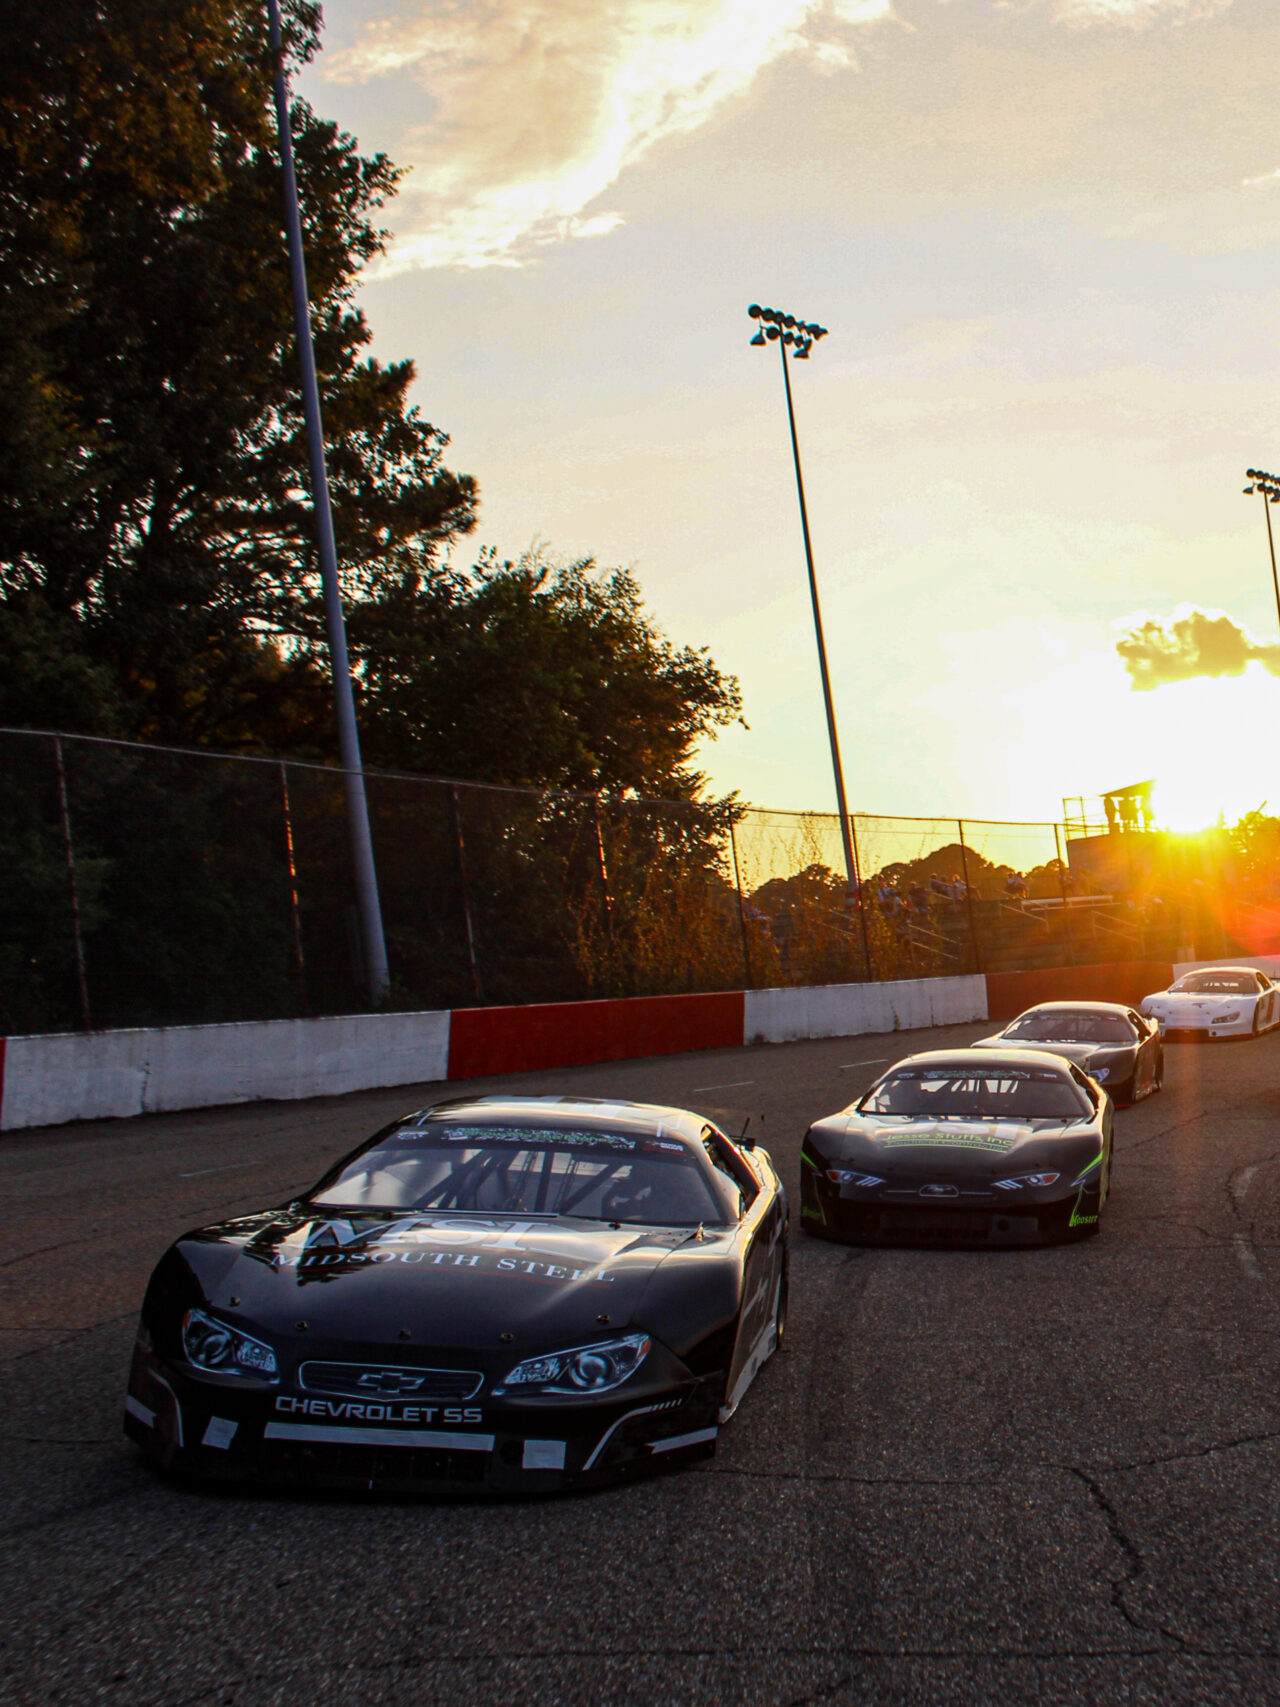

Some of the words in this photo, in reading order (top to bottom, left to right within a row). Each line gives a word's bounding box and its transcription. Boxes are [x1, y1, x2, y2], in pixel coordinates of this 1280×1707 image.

[270, 1251, 480, 1268] MIDSOUTH
[497, 1258, 616, 1283] STEEL
[274, 1395, 439, 1423] CHEVROLET
[443, 1408, 484, 1423] SS
